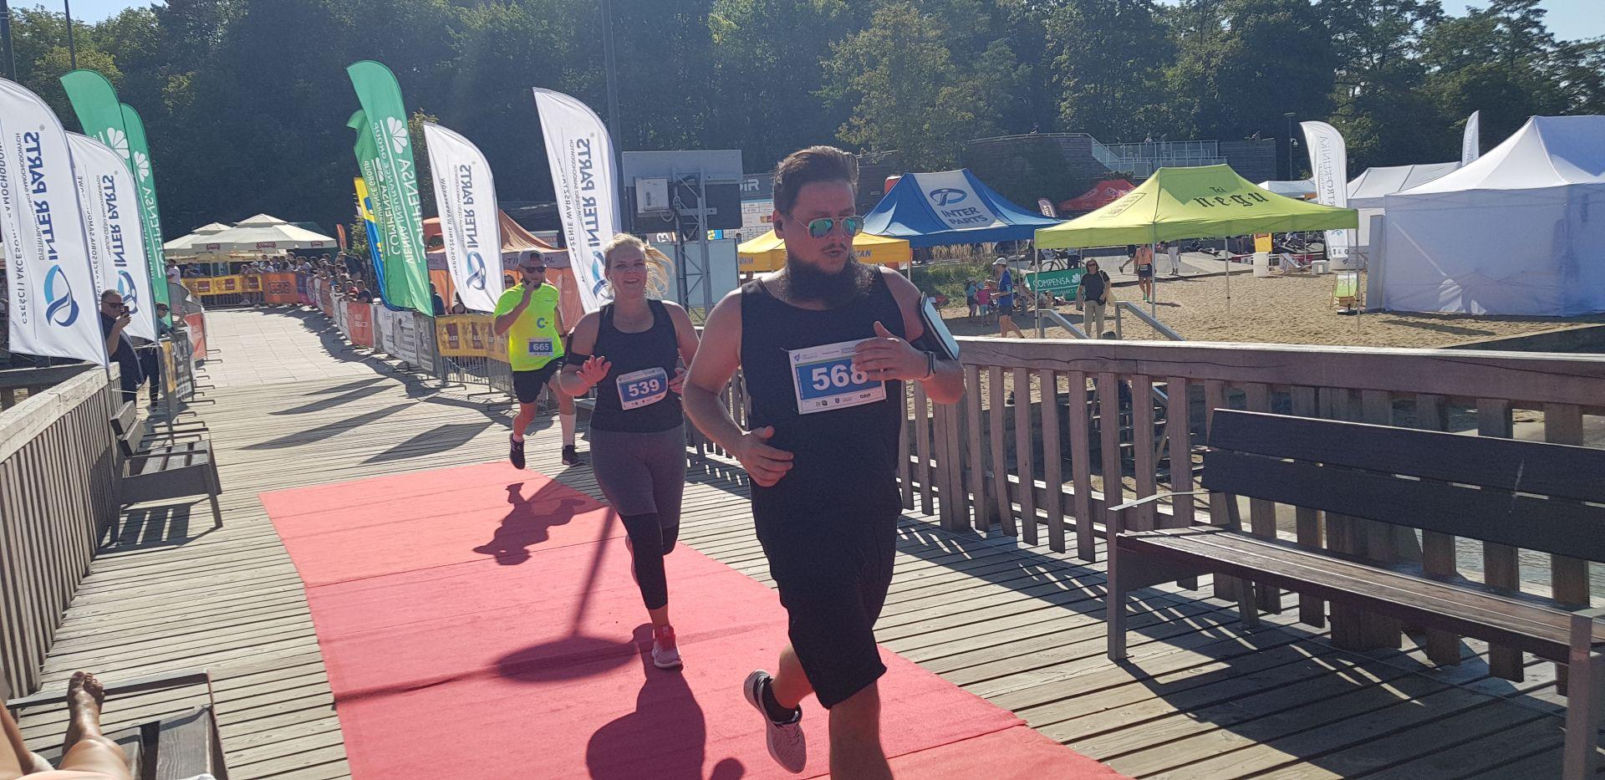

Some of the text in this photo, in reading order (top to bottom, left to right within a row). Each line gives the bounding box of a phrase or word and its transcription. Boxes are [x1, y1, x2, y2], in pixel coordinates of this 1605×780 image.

[941, 206, 980, 217] INTER
[948, 214, 988, 224] PARTS
[1032, 276, 1070, 288] COMPENSA
[533, 343, 550, 351] 665
[811, 363, 869, 391] 568
[628, 378, 660, 397] 539
